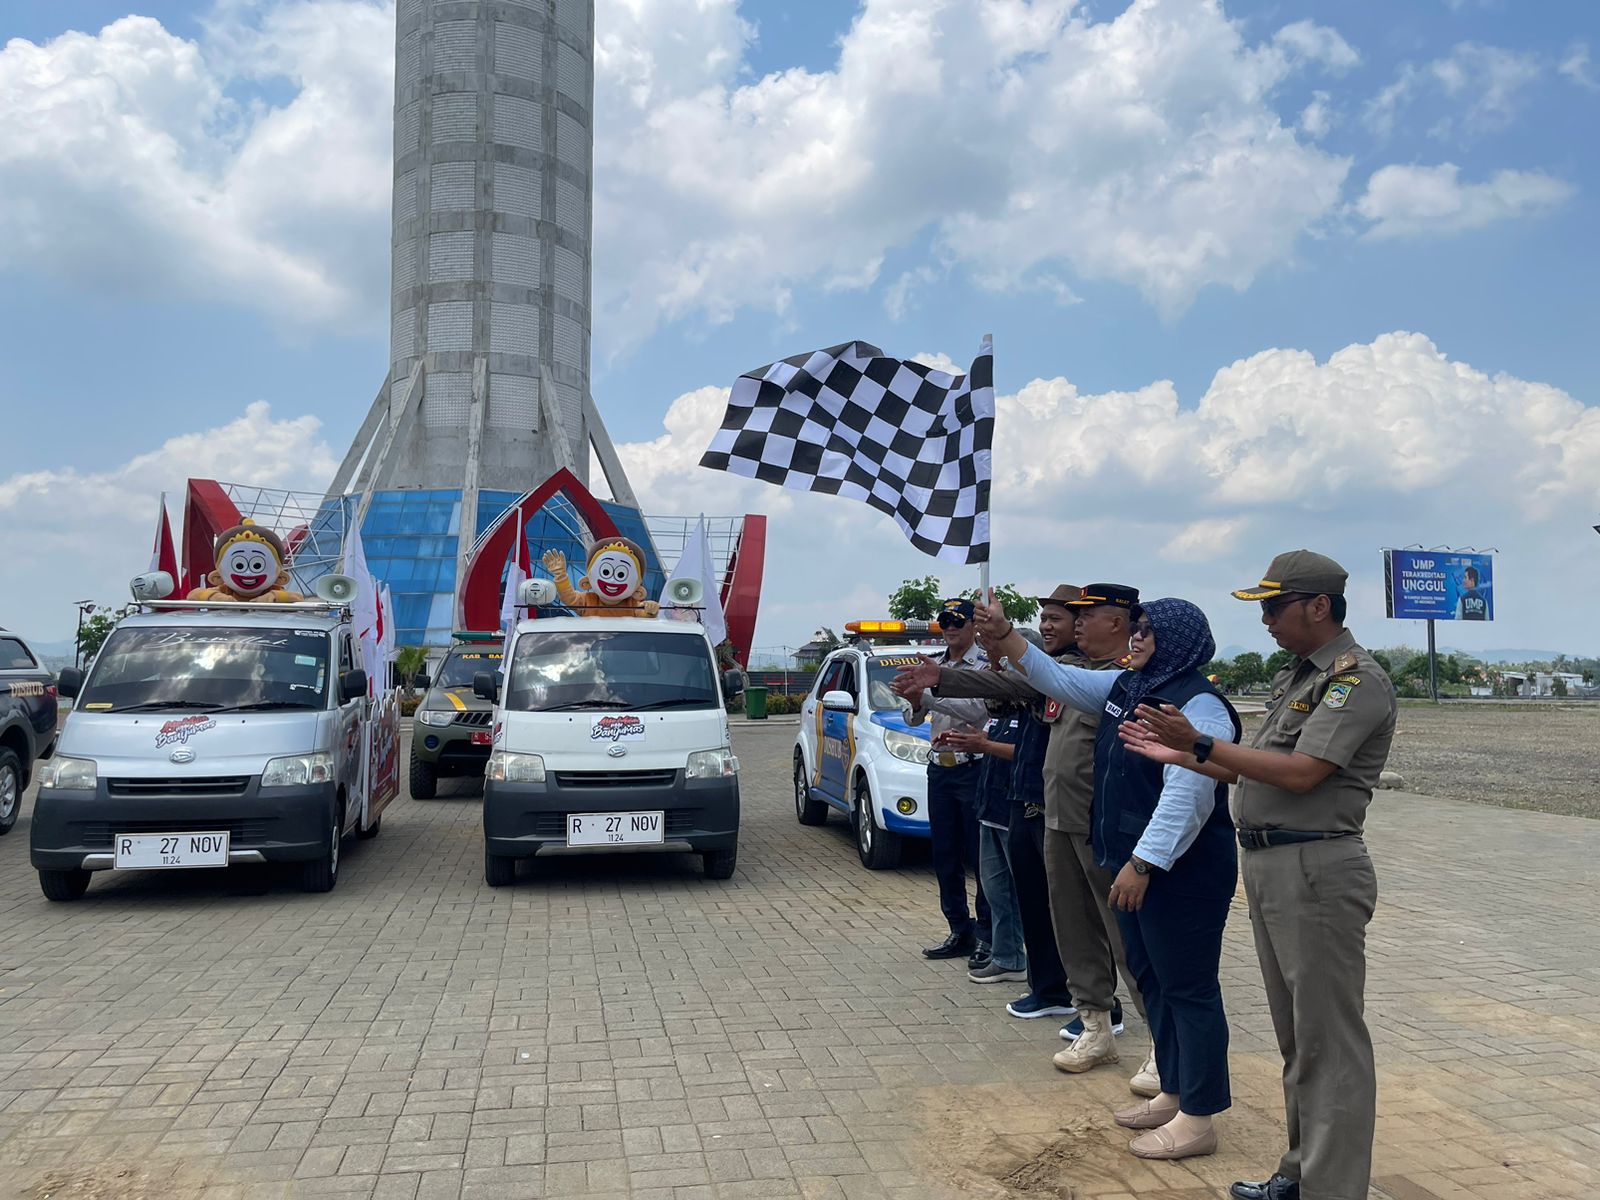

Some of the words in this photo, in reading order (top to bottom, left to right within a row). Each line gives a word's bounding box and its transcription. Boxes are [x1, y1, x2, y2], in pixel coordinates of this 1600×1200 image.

[1412, 559, 1435, 569] UMP
[1402, 579, 1446, 592] UNGGUL
[1465, 598, 1483, 609] UMP
[880, 657, 920, 667] DISHU
[1107, 704, 1121, 716] BMS
[572, 818, 582, 834] R
[605, 817, 622, 832] 27
[631, 816, 658, 831] NOV
[121, 839, 132, 855] R
[160, 838, 179, 854] 27
[190, 836, 222, 853] NOV
